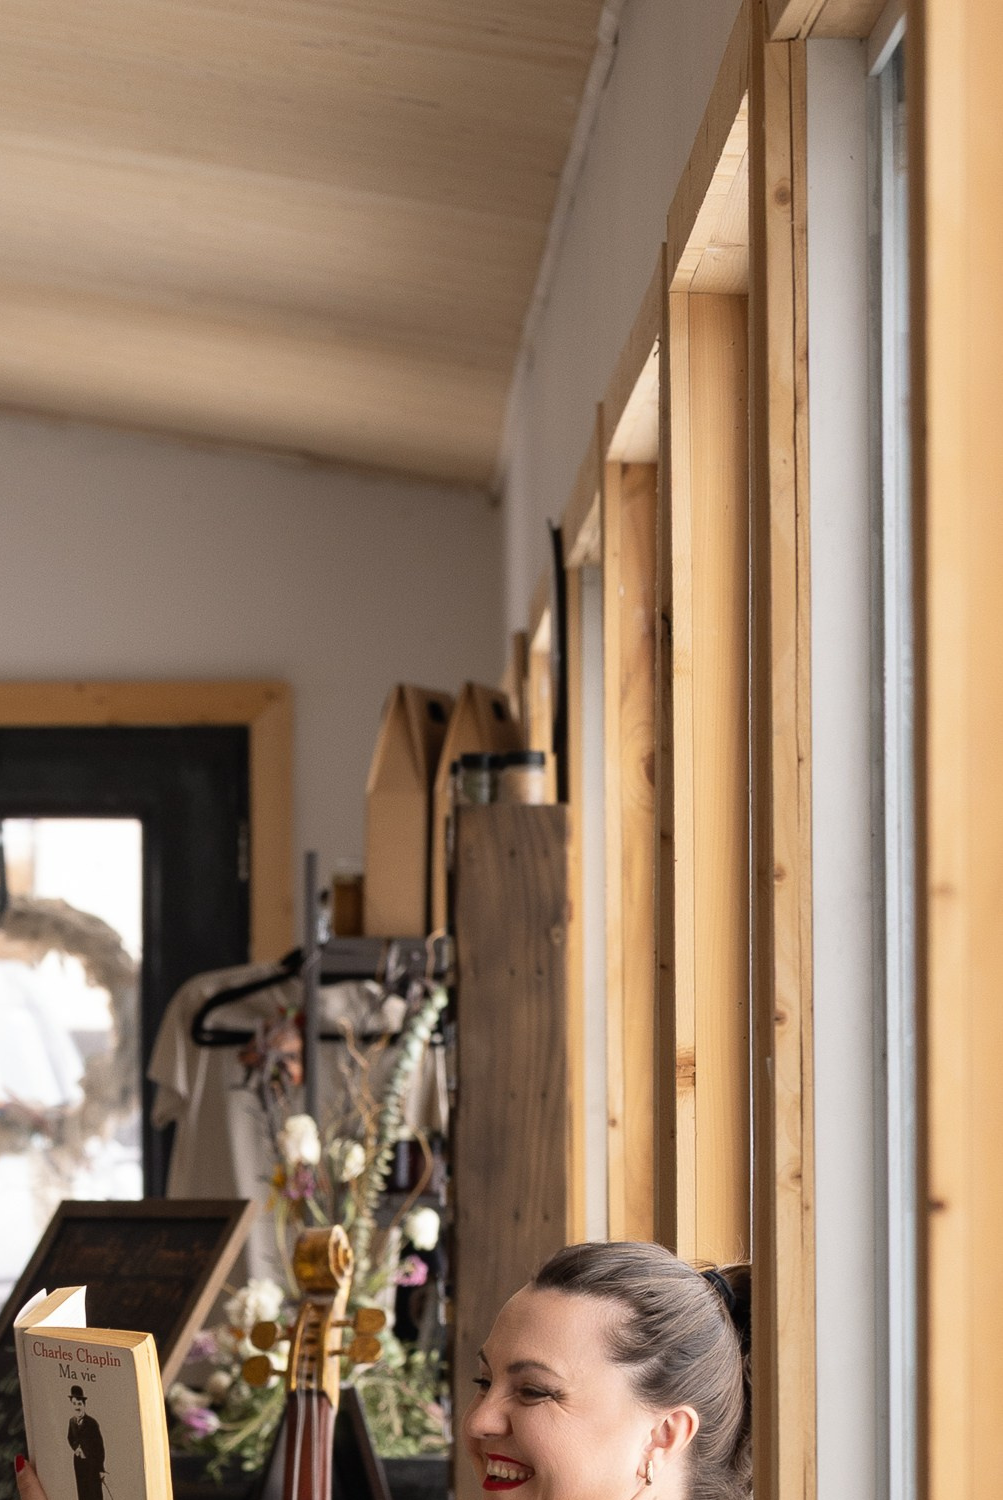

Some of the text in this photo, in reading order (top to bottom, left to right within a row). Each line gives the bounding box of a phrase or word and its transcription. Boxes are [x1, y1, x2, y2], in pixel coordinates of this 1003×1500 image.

[33, 1342, 121, 1368] Charles Chaplin
[59, 1363, 96, 1382] Ma vie
